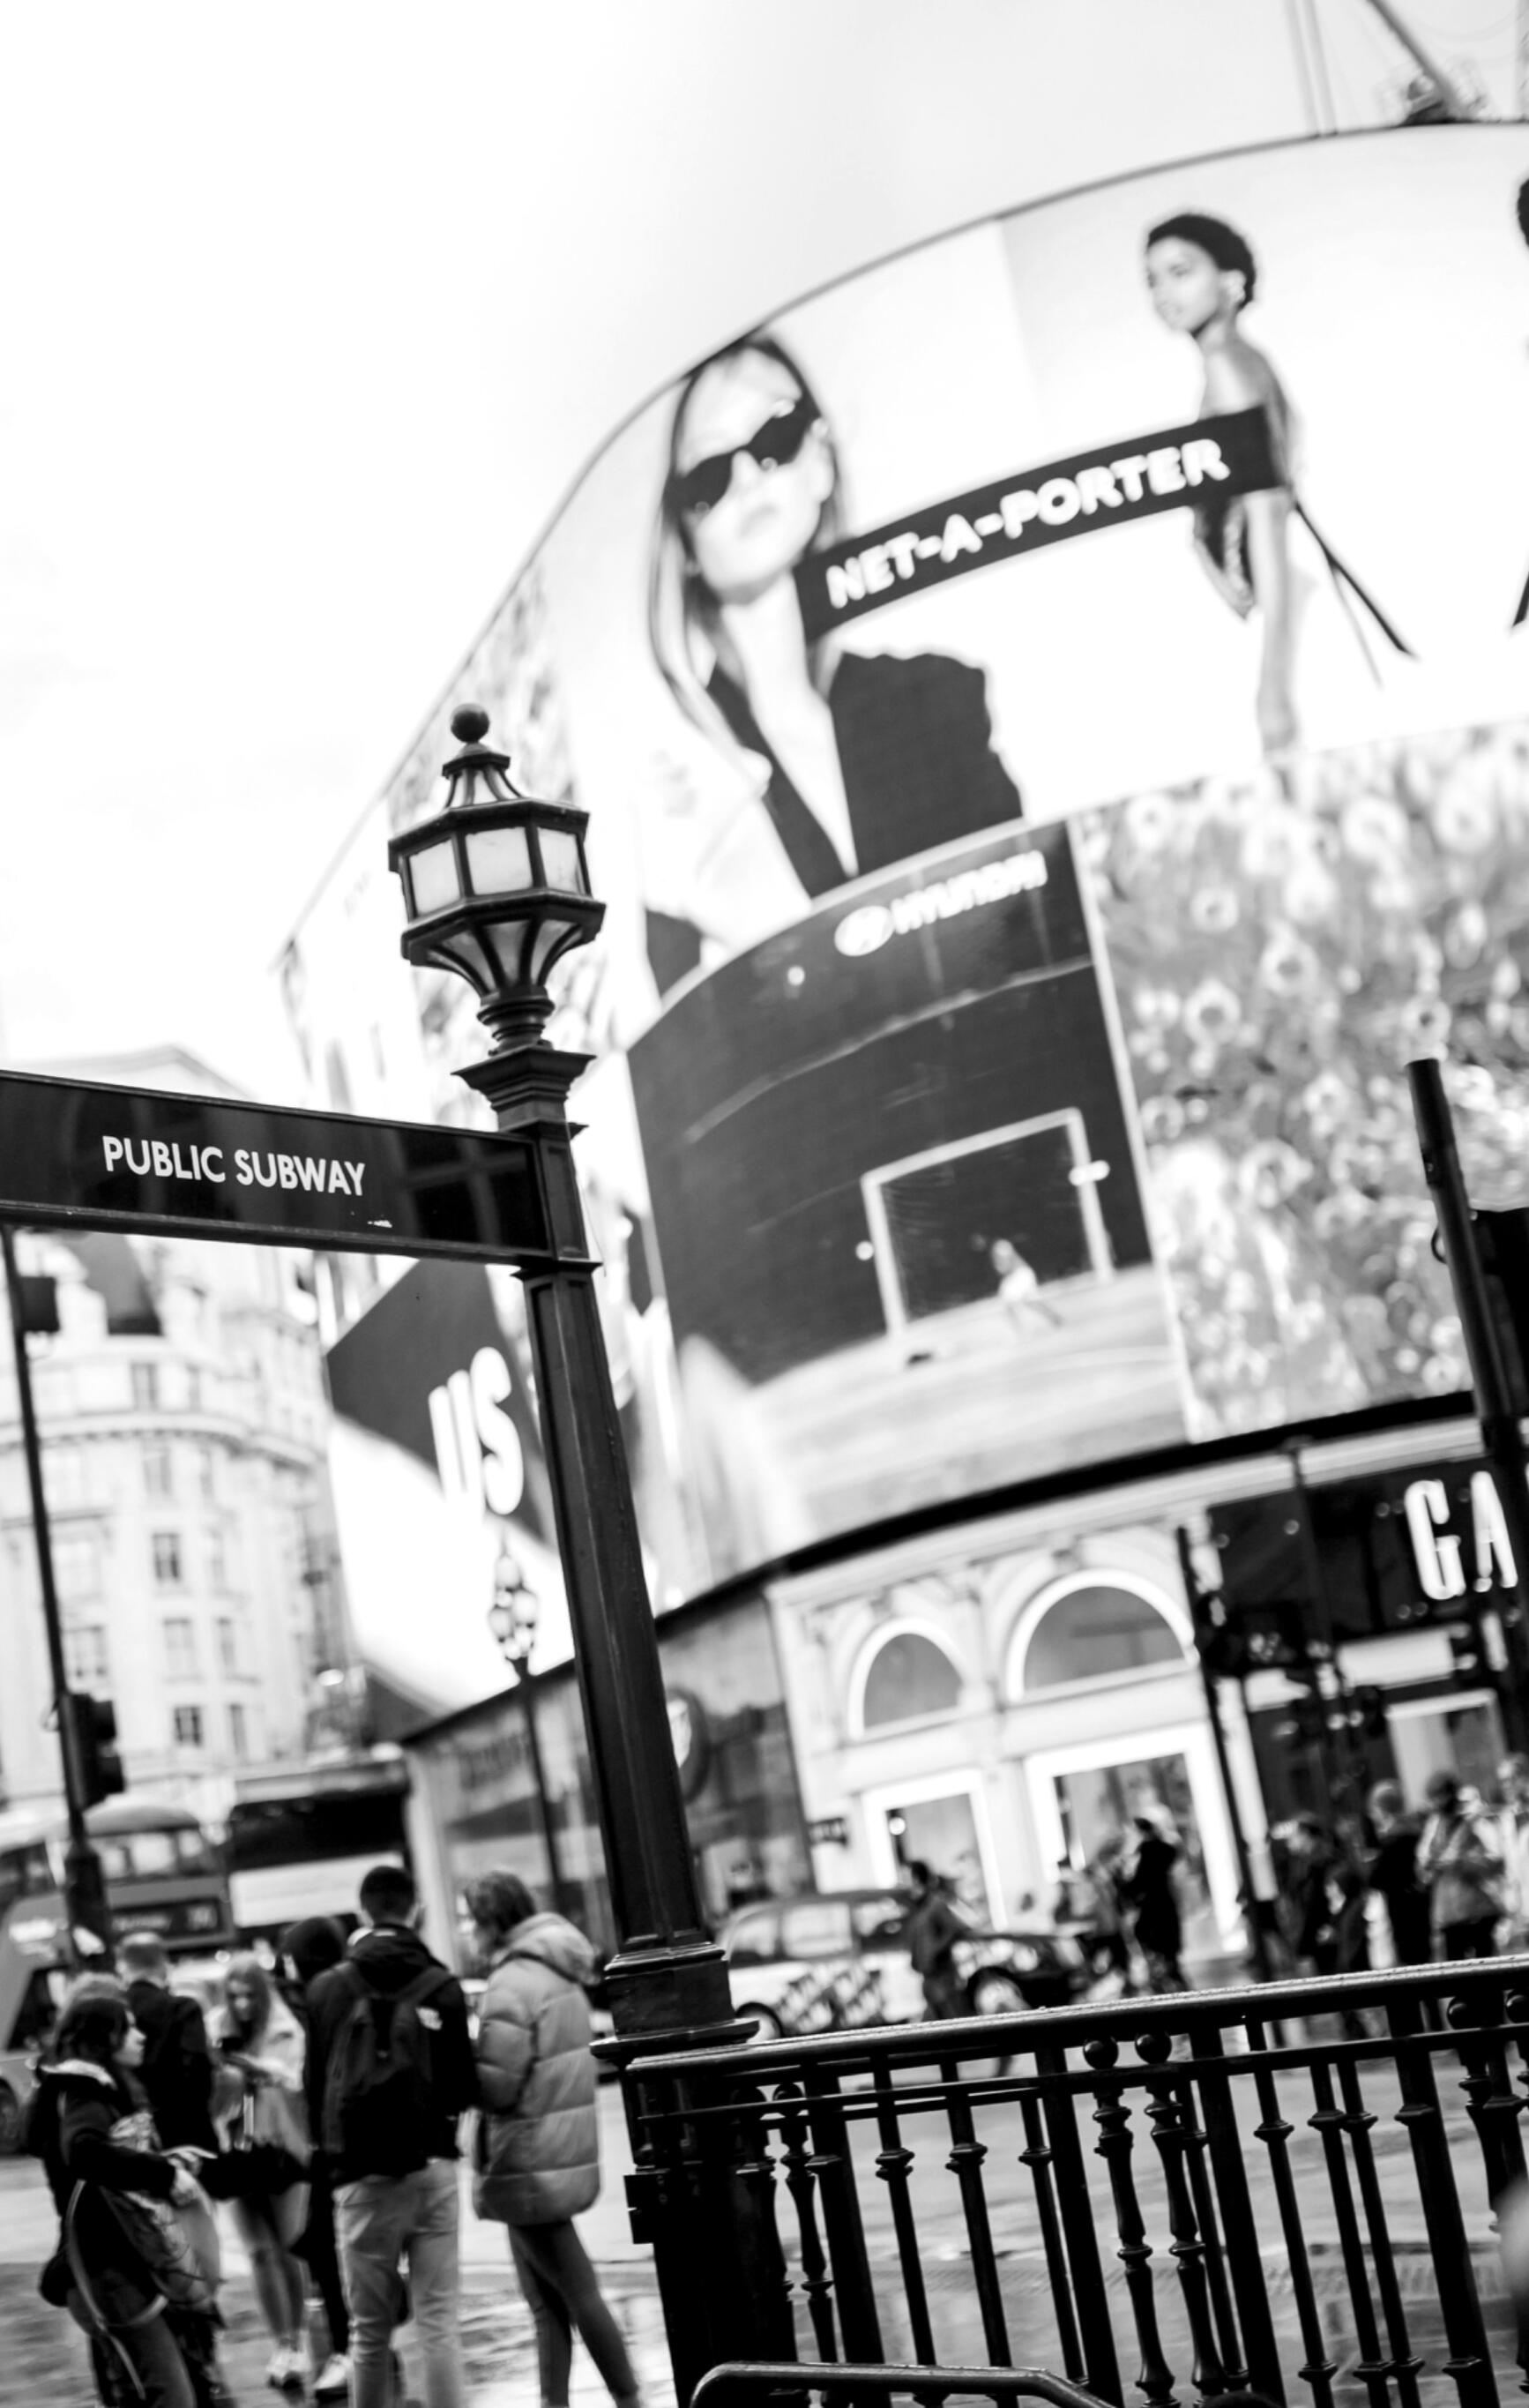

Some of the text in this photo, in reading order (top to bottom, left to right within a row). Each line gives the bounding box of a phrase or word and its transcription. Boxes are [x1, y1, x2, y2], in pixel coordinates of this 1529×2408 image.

[825, 438, 1231, 609] NET-A-PORTER
[891, 849, 1048, 935] HYUNDAI
[102, 1135, 365, 1196] PUBLIC SUBWAY
[1404, 1462, 1529, 1600] GA
